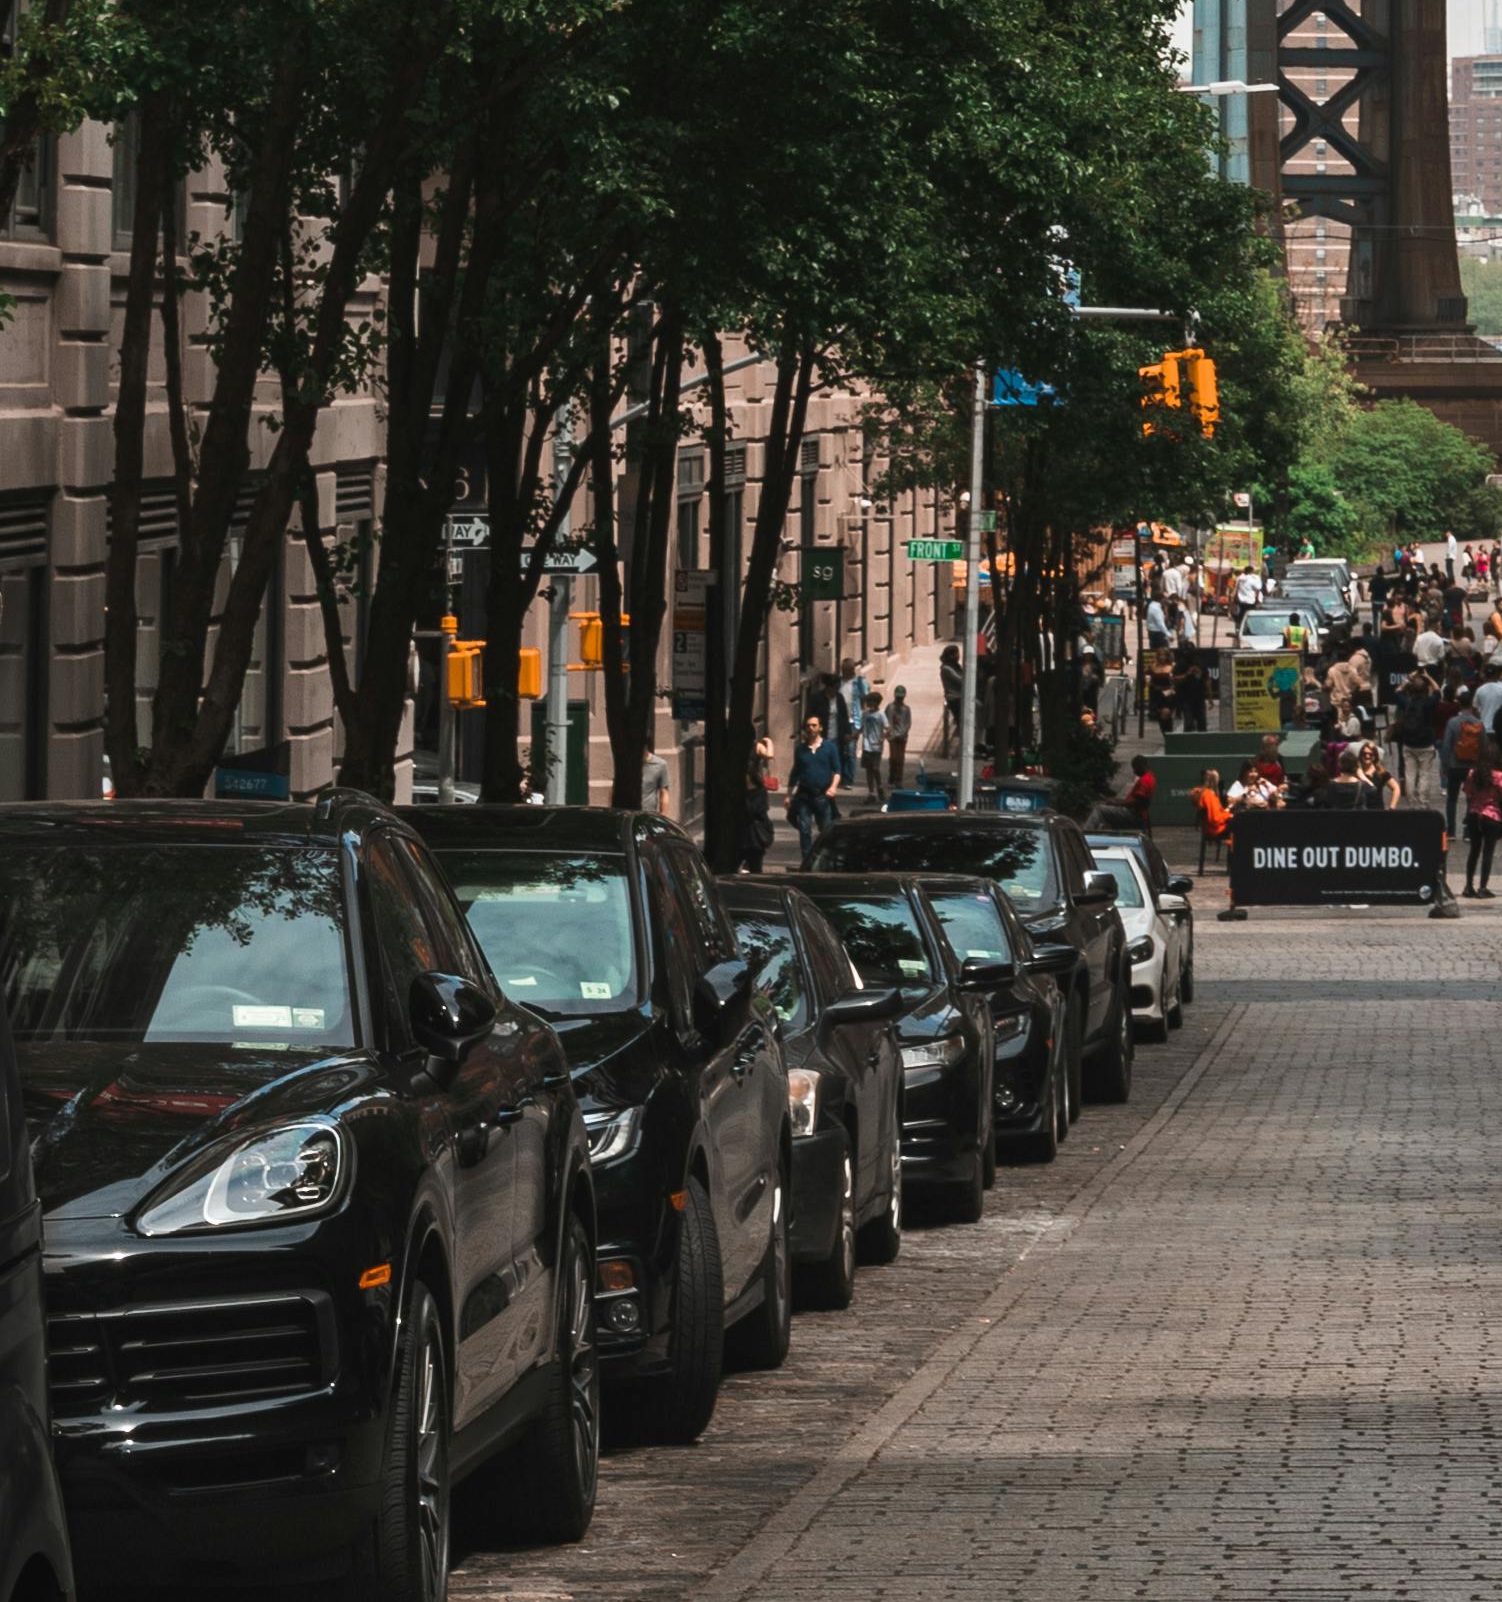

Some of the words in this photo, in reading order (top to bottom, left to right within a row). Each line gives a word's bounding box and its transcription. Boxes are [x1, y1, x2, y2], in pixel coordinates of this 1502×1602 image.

[910, 541, 947, 558] FRONT
[952, 543, 961, 552] ST
[552, 554, 576, 566] WAY
[812, 566, 834, 581] sg
[1254, 847, 1298, 868] DINE
[1302, 847, 1340, 868] OUT
[1345, 846, 1419, 868] DUMBO.
